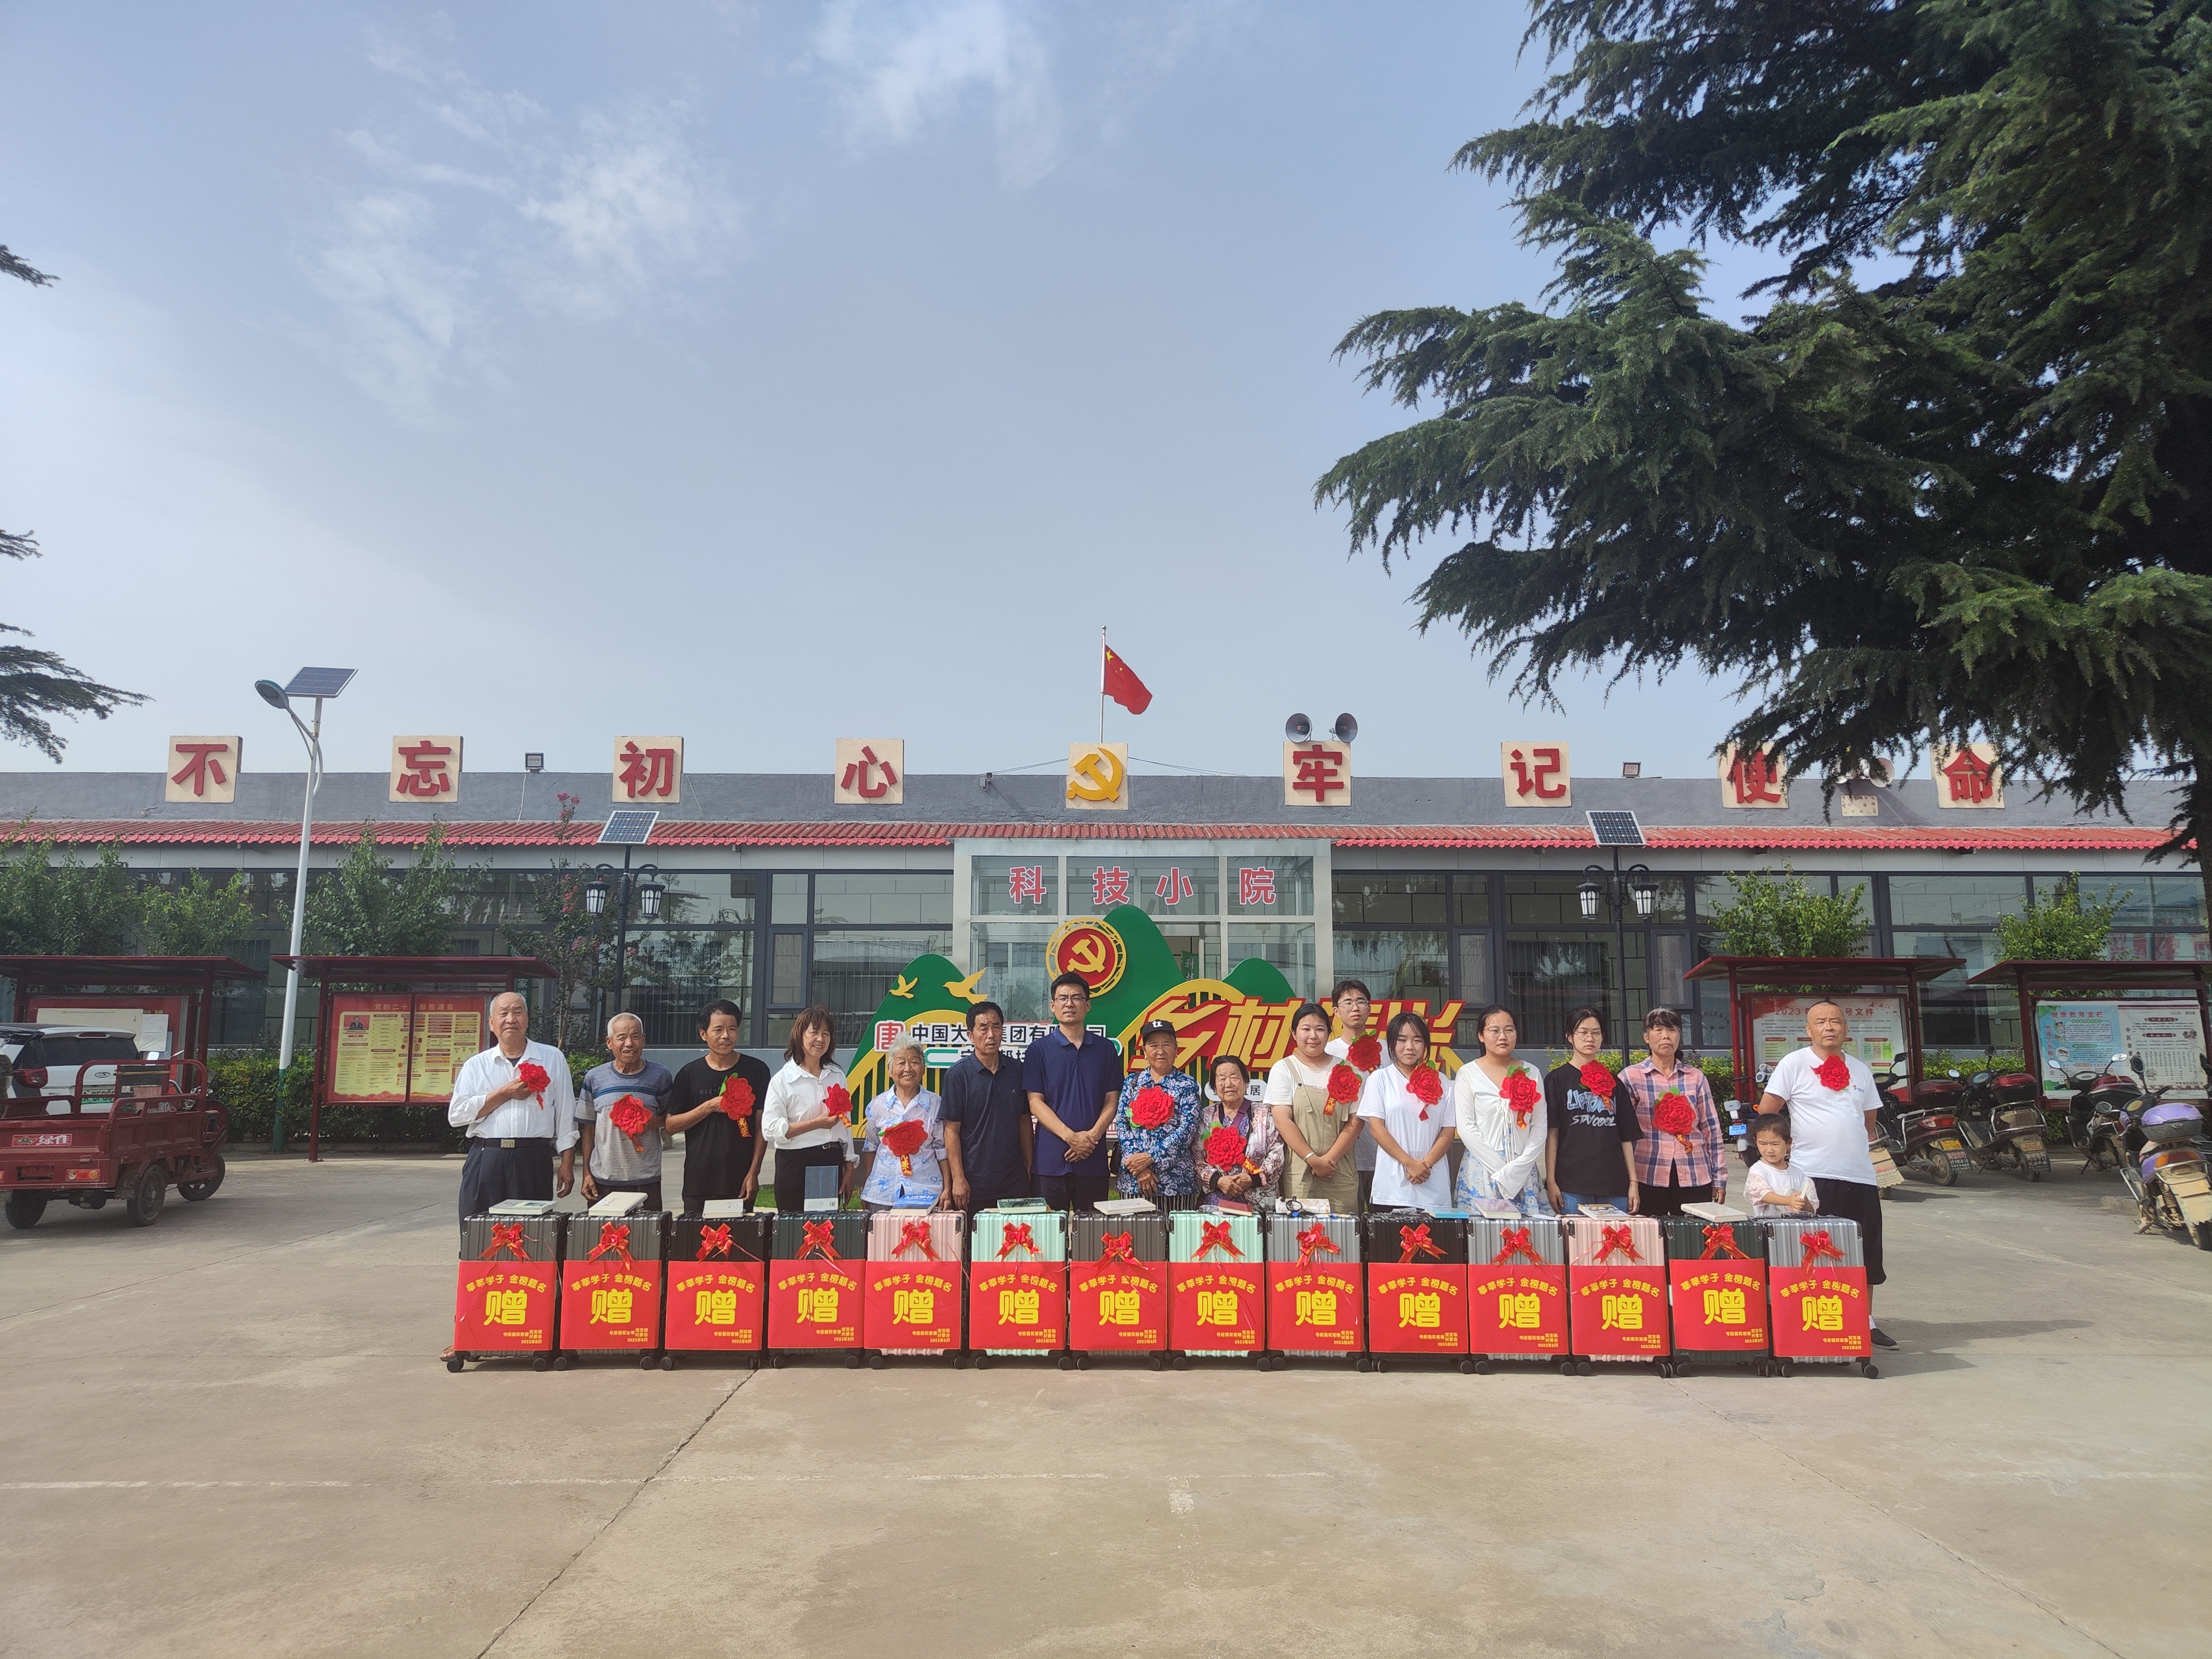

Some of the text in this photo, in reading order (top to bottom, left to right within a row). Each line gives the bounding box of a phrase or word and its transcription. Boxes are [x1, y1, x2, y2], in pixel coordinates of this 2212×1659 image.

[172, 740, 1993, 804] 不忘初心 牢记使命
[1009, 865, 1277, 906] 科技小院
[374, 1003, 455, 1011] 党的二十报告速览
[36, 1135, 71, 1145] 绿佳
[466, 1274, 547, 1293] 莘莘学子 金榜题名
[571, 1273, 652, 1292] 莘莘学子 金榜题名
[676, 1274, 755, 1293] 莘莘学子 金榜题名
[778, 1272, 857, 1291] 莘莘学子 金榜题名
[873, 1274, 952, 1292] 莘莘学子 金榜题名
[979, 1274, 1057, 1293] 莘莘学子 金榜题名
[1078, 1274, 1158, 1293] 莘莘学子 金榜题名
[1176, 1274, 1256, 1294] 莘莘学子 金榜题名
[1275, 1274, 1354, 1294] 莘莘学子 金榜题名
[1378, 1277, 1458, 1296] 莘莘学子 金榜题名
[1477, 1277, 1558, 1296] 莘莘学子 金榜题名
[1580, 1278, 1660, 1297] 莘莘学子 金榜题名
[1680, 1272, 1760, 1291] 莘莘学子 金榜题名
[1780, 1279, 1860, 1298] 莘莘学子 金榜题名
[484, 1290, 527, 1325] 赠
[590, 1289, 632, 1324] 赠
[694, 1290, 736, 1325] 赠
[797, 1287, 838, 1323] 赠
[893, 1289, 934, 1324] 赠
[999, 1289, 1039, 1325] 赠
[1099, 1290, 1139, 1325] 赠
[1197, 1290, 1237, 1325] 赠
[1296, 1290, 1336, 1325] 赠
[1399, 1292, 1440, 1327] 赠
[1499, 1293, 1540, 1328] 赠
[1602, 1294, 1642, 1330] 赠
[1704, 1288, 1745, 1324] 赠
[1802, 1295, 1843, 1331] 赠
